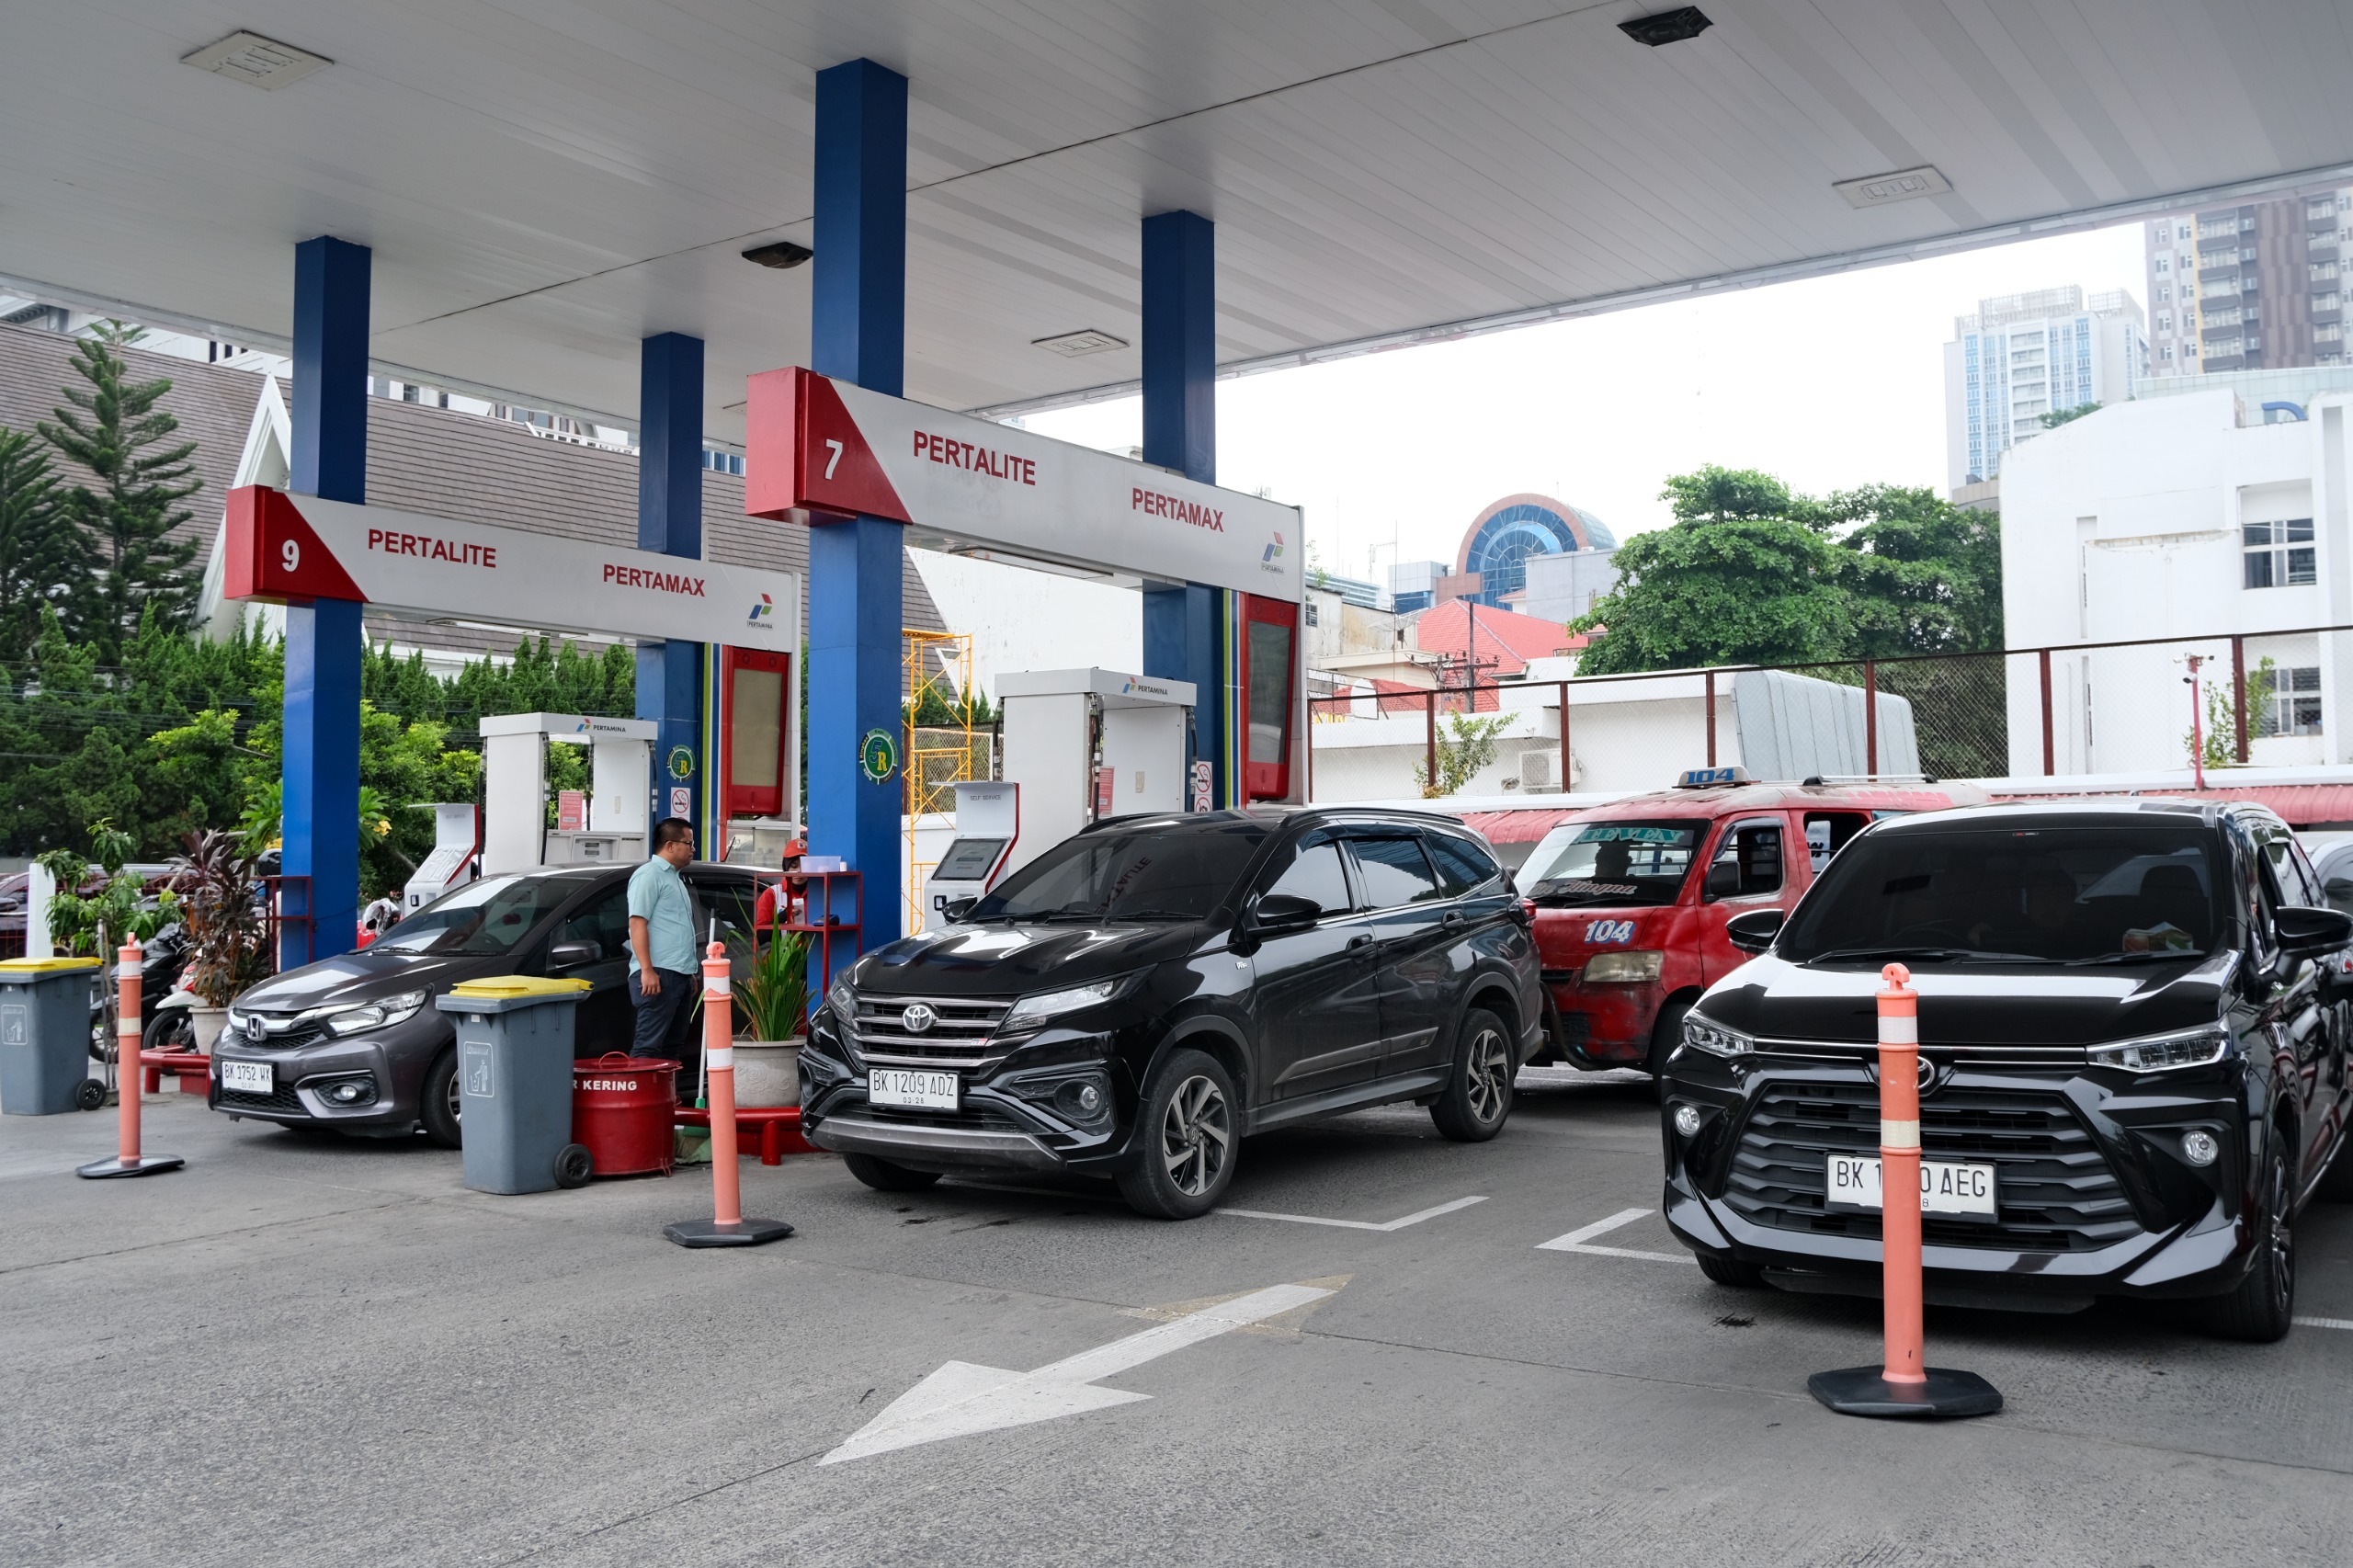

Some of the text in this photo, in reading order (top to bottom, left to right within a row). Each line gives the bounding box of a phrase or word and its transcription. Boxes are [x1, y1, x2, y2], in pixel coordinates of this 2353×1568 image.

[824, 438, 843, 480] 7
[914, 430, 1036, 485] PERTALITE
[1132, 487, 1224, 532] PERTAMAX
[281, 540, 300, 572] 9
[368, 528, 496, 568] PERTALITE
[1261, 562, 1284, 574] PERTAMINA
[603, 563, 705, 597] PERTAMAX
[747, 620, 773, 630] PERTAMINA
[1137, 685, 1168, 696] PERTAMINA
[593, 724, 627, 733] PERTAMINA
[1686, 768, 1734, 784] 104
[1584, 920, 1636, 943] 104
[224, 1063, 235, 1079] BK
[583, 1080, 638, 1091] KERING
[873, 1072, 954, 1096] BK 1209 ADZ
[1837, 1160, 1864, 1188] BK
[1940, 1167, 1985, 1198] AEG
